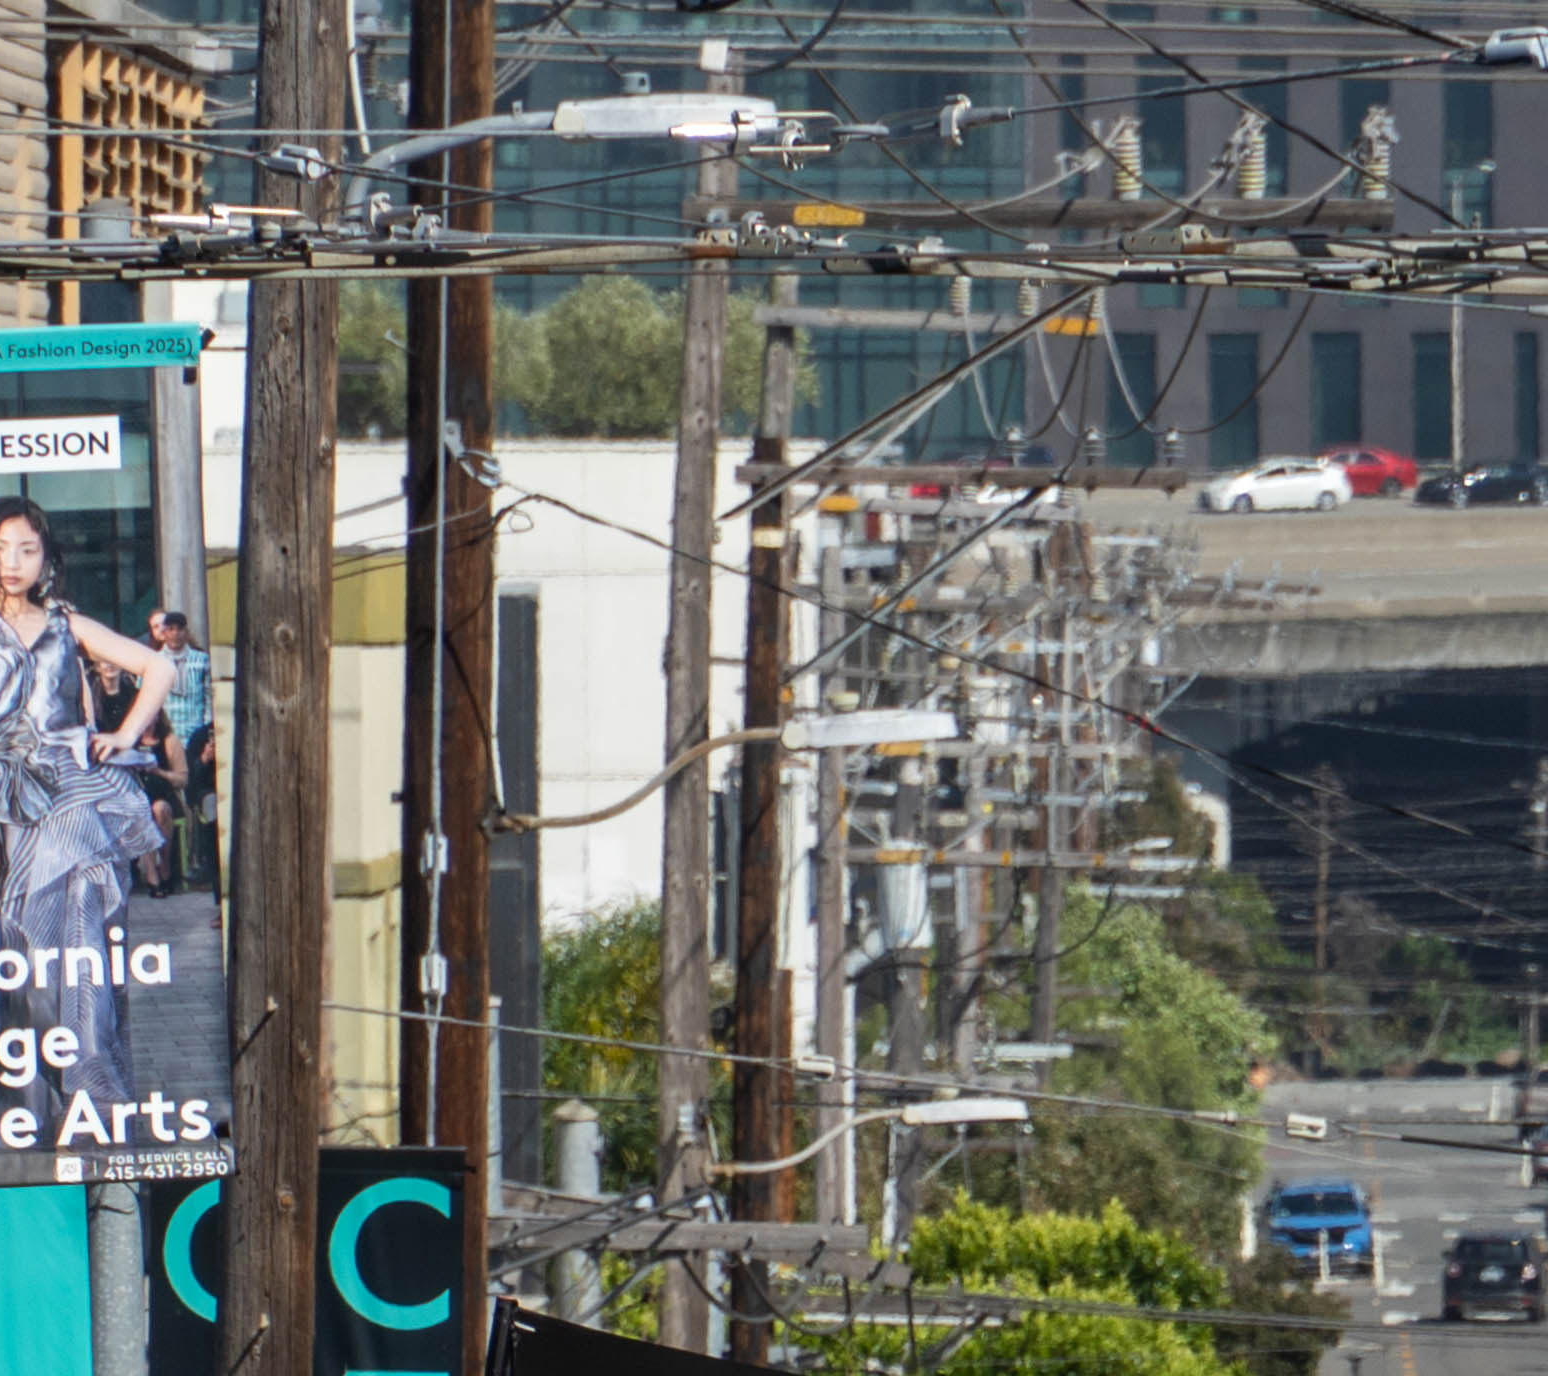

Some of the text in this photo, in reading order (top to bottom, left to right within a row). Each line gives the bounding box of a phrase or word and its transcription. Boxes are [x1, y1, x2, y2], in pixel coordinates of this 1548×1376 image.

[8, 339, 79, 359] Fashion
[82, 338, 141, 360] Design
[146, 337, 194, 357] 2025)
[56, 1090, 213, 1147] Arts
[108, 1150, 228, 1165] FOR SERVICE CALL
[104, 1162, 229, 1181] 415-431-2950
